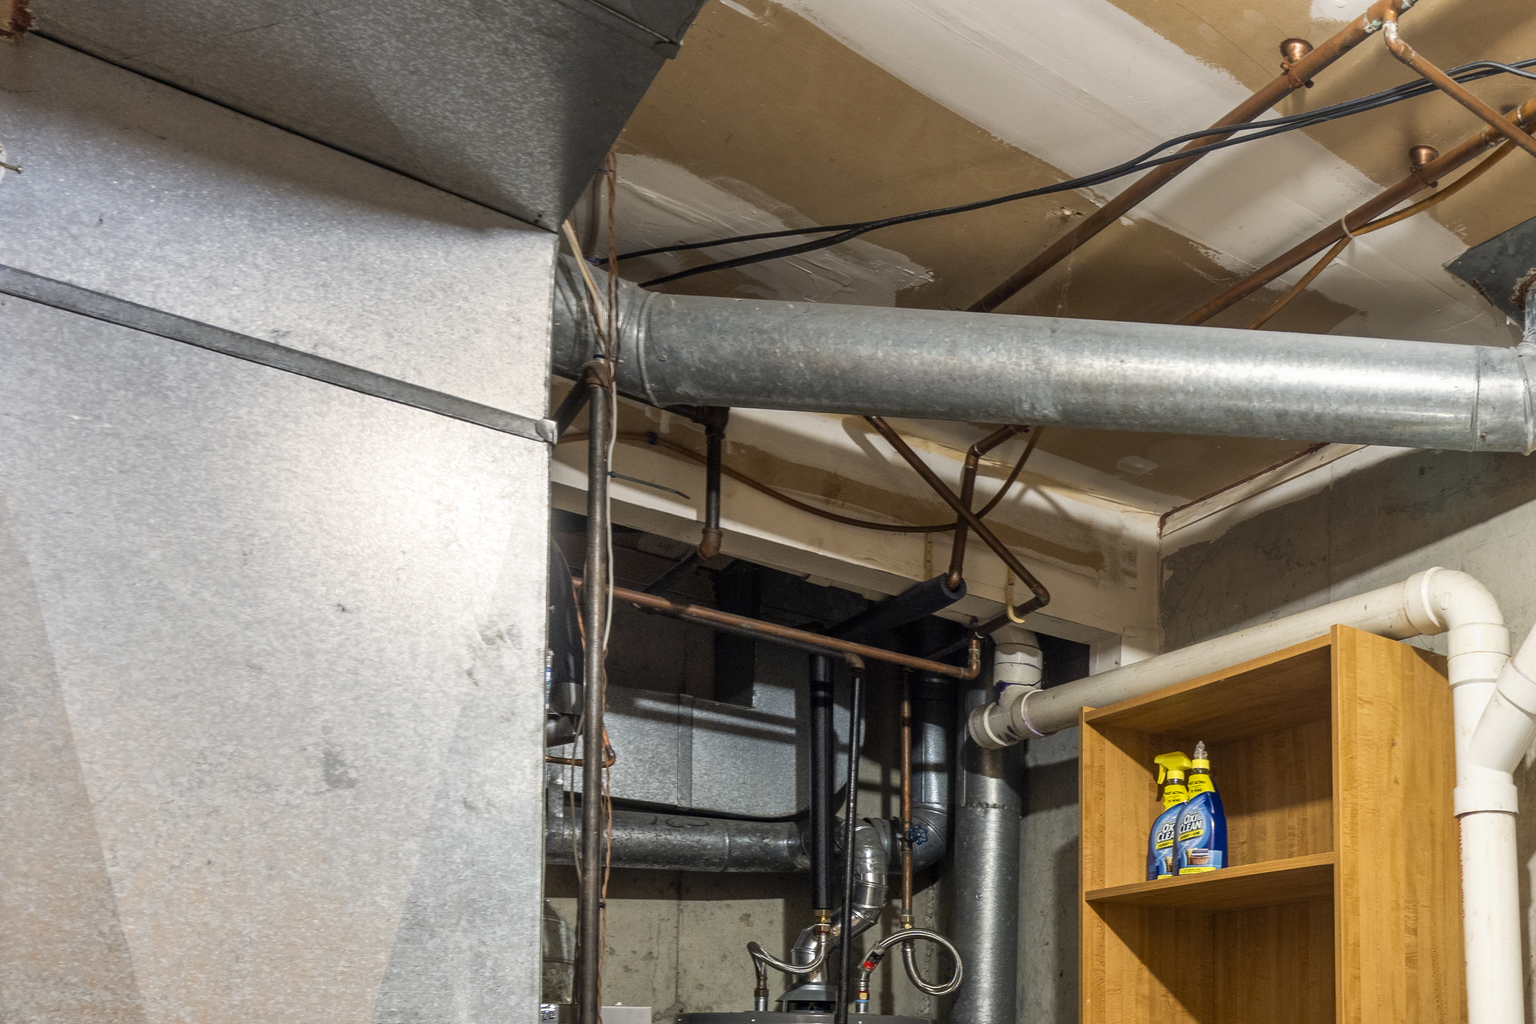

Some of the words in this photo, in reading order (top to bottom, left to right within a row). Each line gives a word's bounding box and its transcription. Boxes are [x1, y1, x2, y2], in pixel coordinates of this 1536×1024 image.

[1184, 812, 1198, 824] OXI
[1180, 820, 1202, 832] CLEAN
[1157, 832, 1174, 842] CLEA
